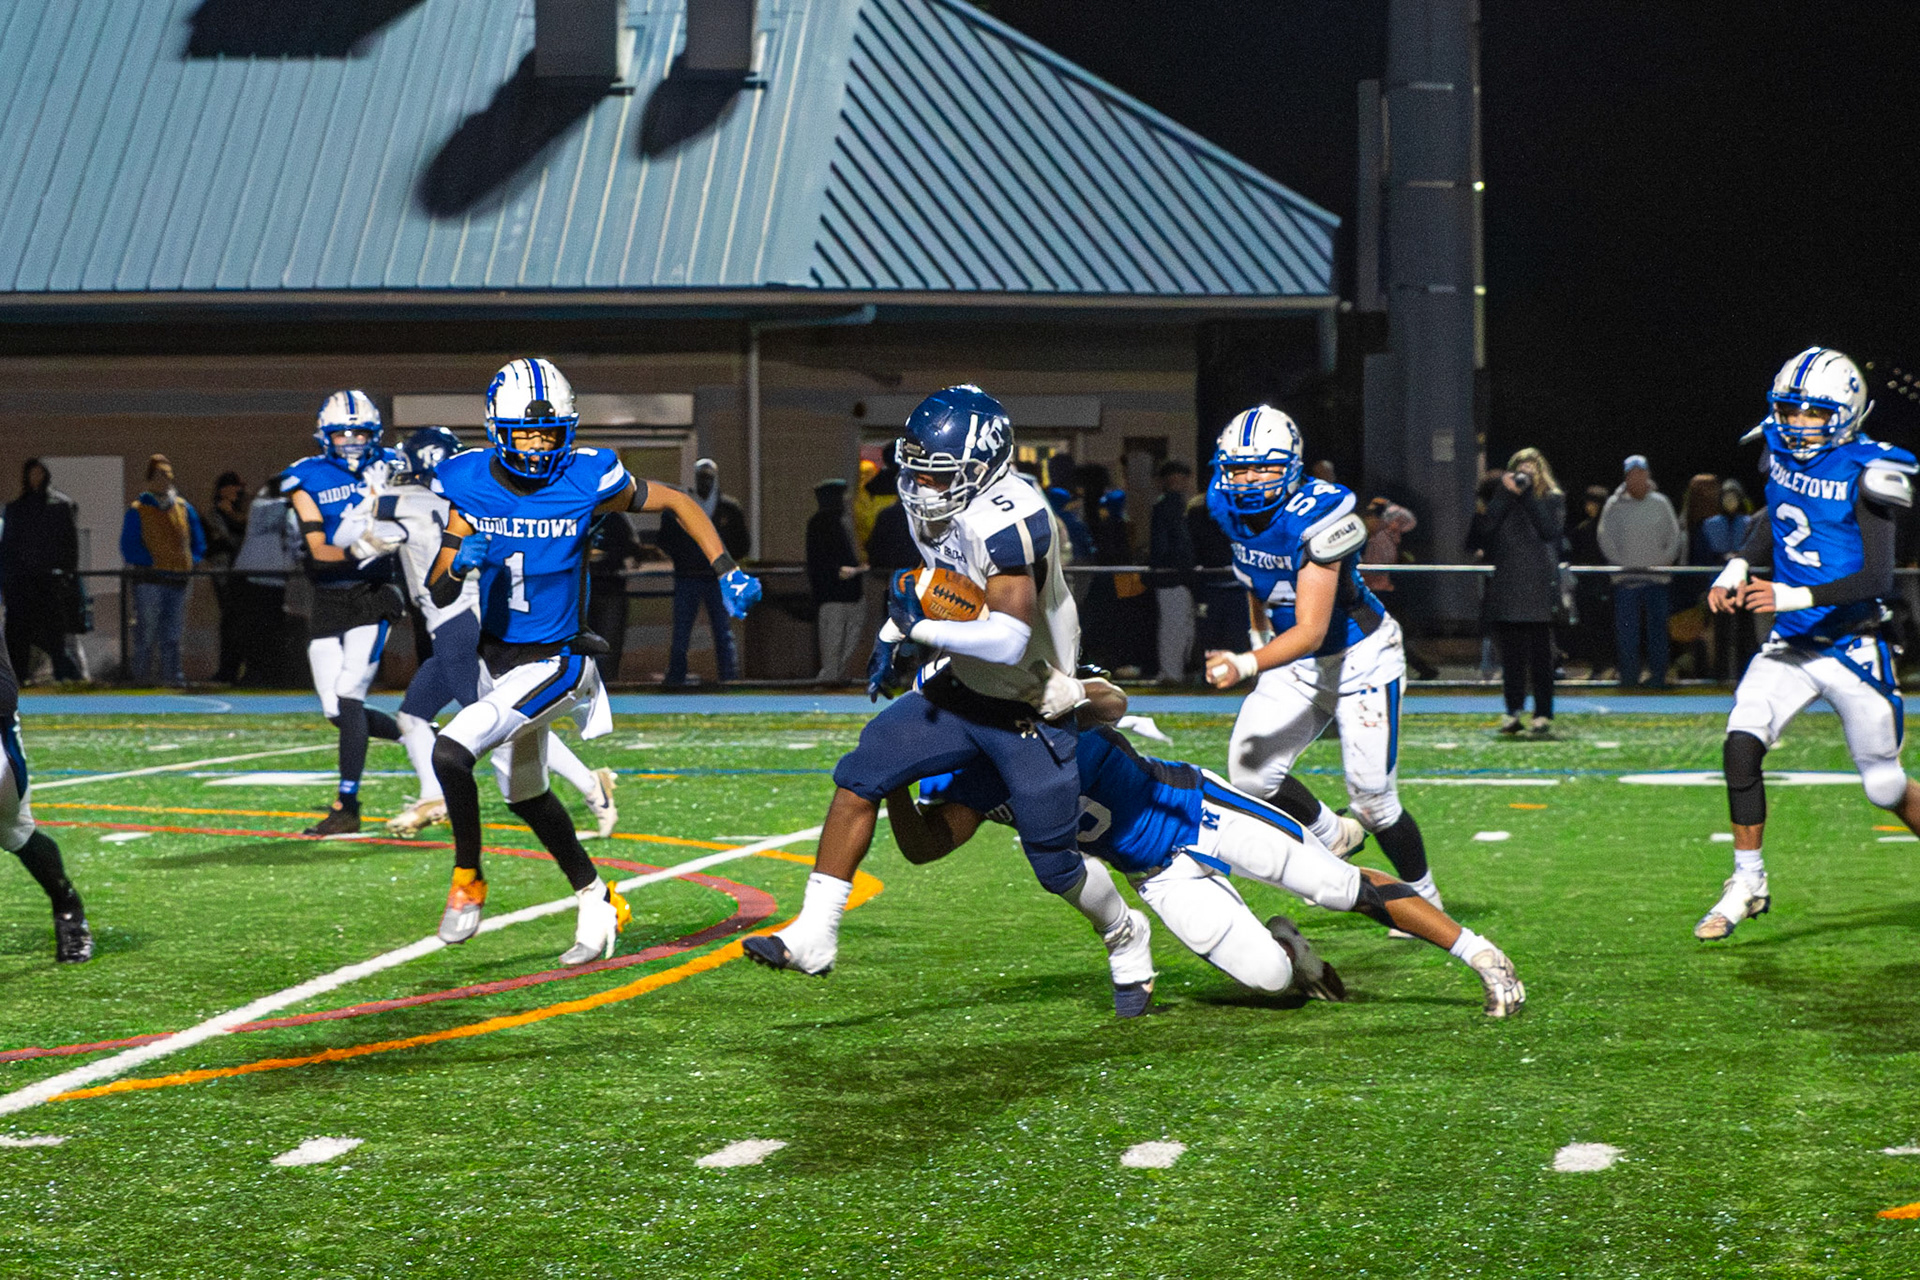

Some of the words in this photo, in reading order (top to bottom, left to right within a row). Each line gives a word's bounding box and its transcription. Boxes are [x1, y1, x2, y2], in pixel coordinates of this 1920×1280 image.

[991, 494, 1015, 512] 5
[1284, 483, 1342, 517] 54
[1775, 502, 1822, 568] 2
[504, 551, 530, 613] 1
